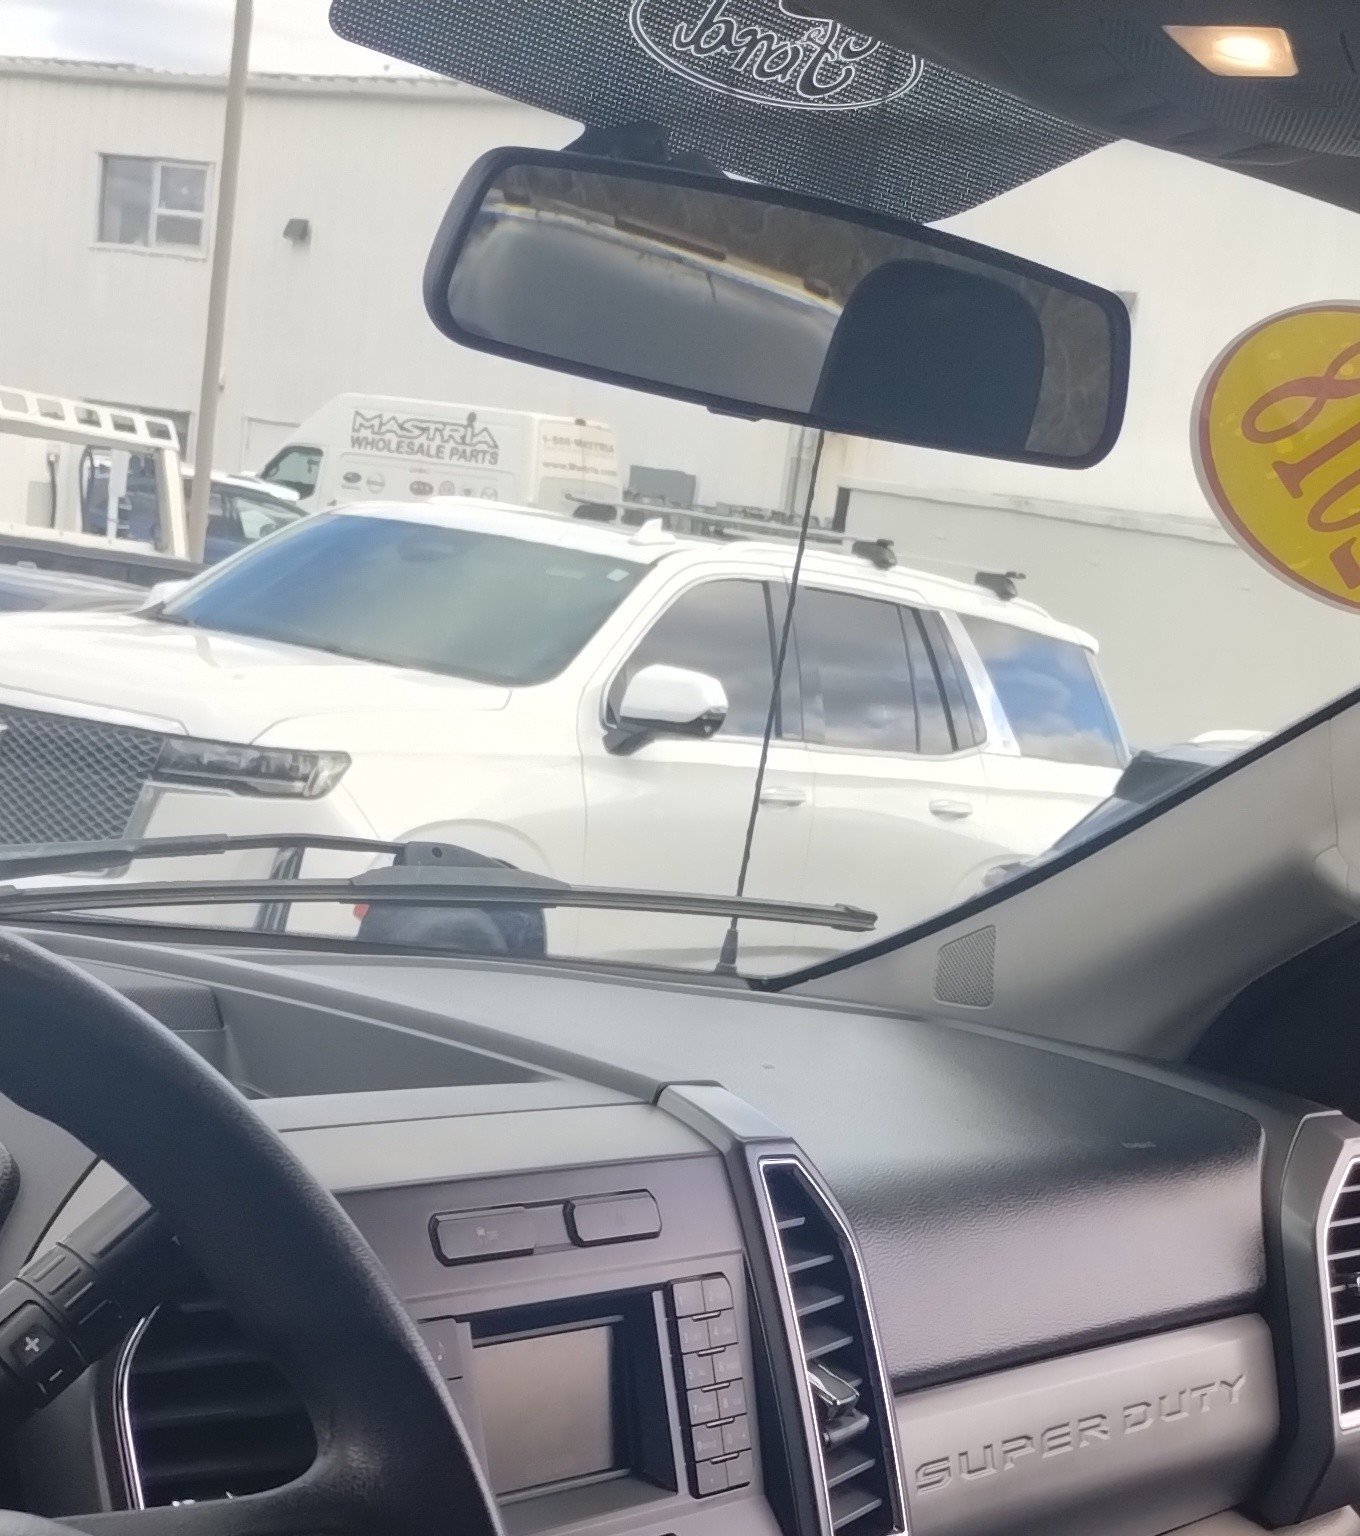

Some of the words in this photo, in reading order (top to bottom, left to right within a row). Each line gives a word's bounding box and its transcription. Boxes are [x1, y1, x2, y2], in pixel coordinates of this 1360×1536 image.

[350, 435, 444, 460] WHOLESALE
[449, 449, 498, 466] PARTS
[914, 1413, 1111, 1495] SUPER
[1122, 1373, 1247, 1435] DUTY
